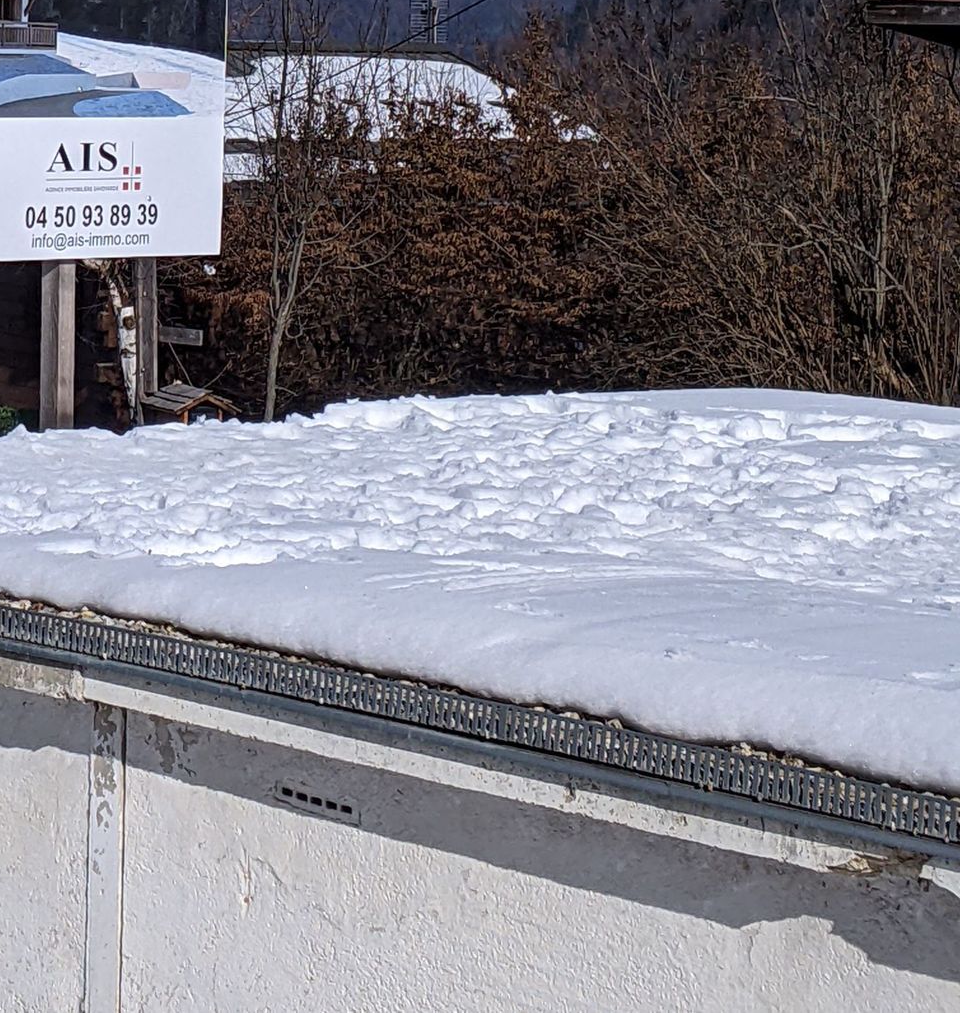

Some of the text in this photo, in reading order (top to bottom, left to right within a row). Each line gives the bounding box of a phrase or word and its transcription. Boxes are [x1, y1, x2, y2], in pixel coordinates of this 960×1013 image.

[46, 142, 118, 172] AIS
[25, 203, 158, 229] 04 50 93 89 39
[31, 233, 150, 251] info@ais-immo.com
